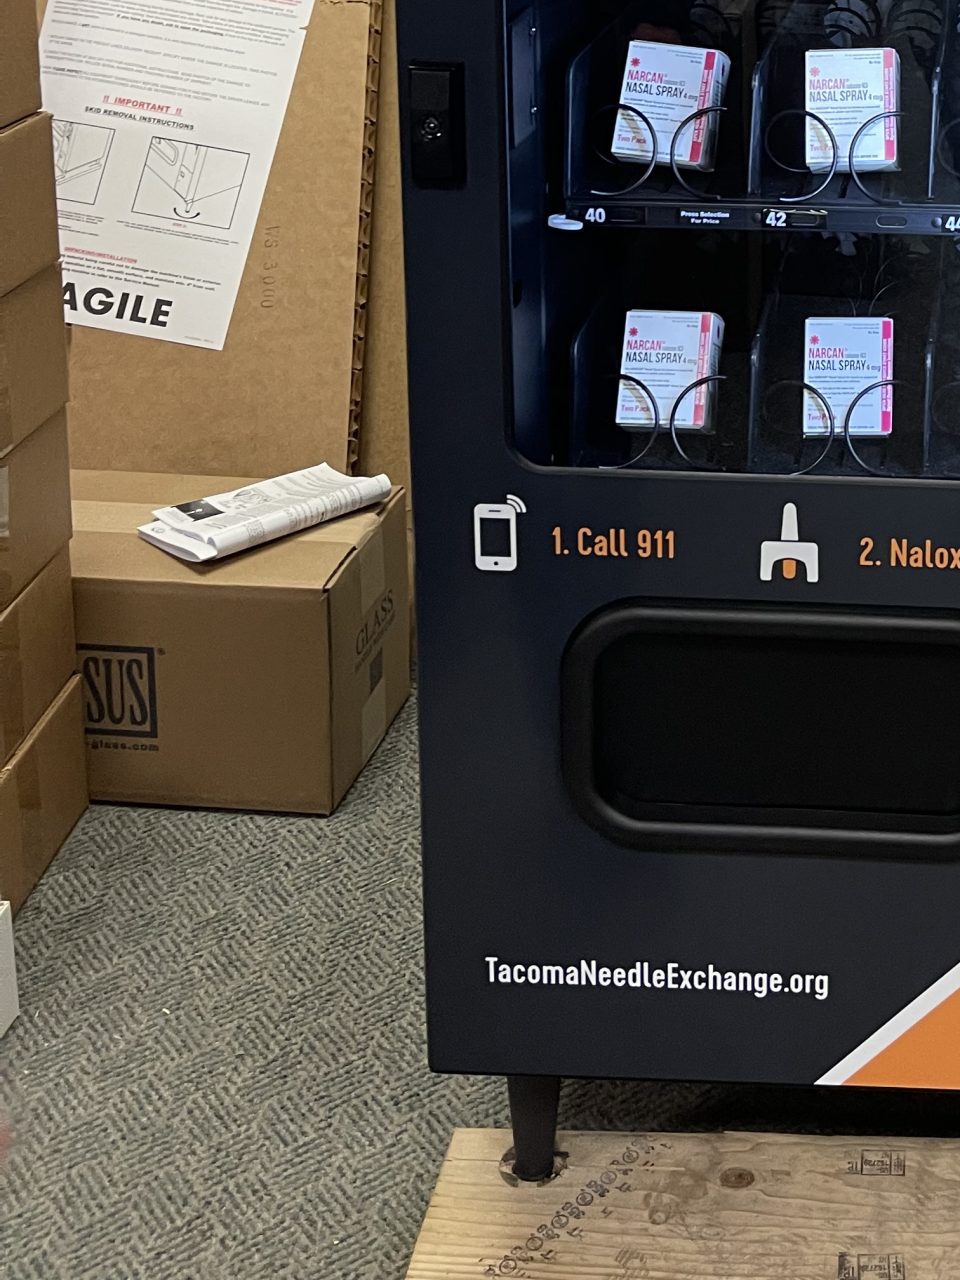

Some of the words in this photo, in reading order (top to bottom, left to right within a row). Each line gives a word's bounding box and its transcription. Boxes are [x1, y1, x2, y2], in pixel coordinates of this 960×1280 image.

[627, 69, 664, 84] NARCAN
[809, 78, 846, 90] NARCAN
[625, 81, 654, 95] NASAL
[655, 85, 685, 99] SPRAY
[809, 90, 839, 103] NASAL
[840, 90, 868, 102] SPRAY
[114, 96, 171, 114] IMPORTANT
[85, 106, 101, 114] SKID
[103, 109, 137, 121] REMOVAL
[139, 115, 194, 130] INSTRUCTIONS
[585, 207, 606, 223] 40
[765, 212, 787, 227] 42
[626, 339, 662, 351] NARCAN
[808, 347, 844, 358] NARCAN
[625, 351, 653, 363] NASAL
[655, 353, 684, 364] SPRAY
[808, 359, 837, 371] NASAL
[838, 360, 866, 371] SPRAY
[552, 527, 570, 556] 1.
[577, 527, 629, 557] Call
[637, 530, 676, 559] 911
[859, 537, 882, 567] 2.
[356, 588, 394, 656] GLASS
[83, 656, 148, 726] SUS
[485, 956, 829, 1000] TacomaNeedleExchange.org
